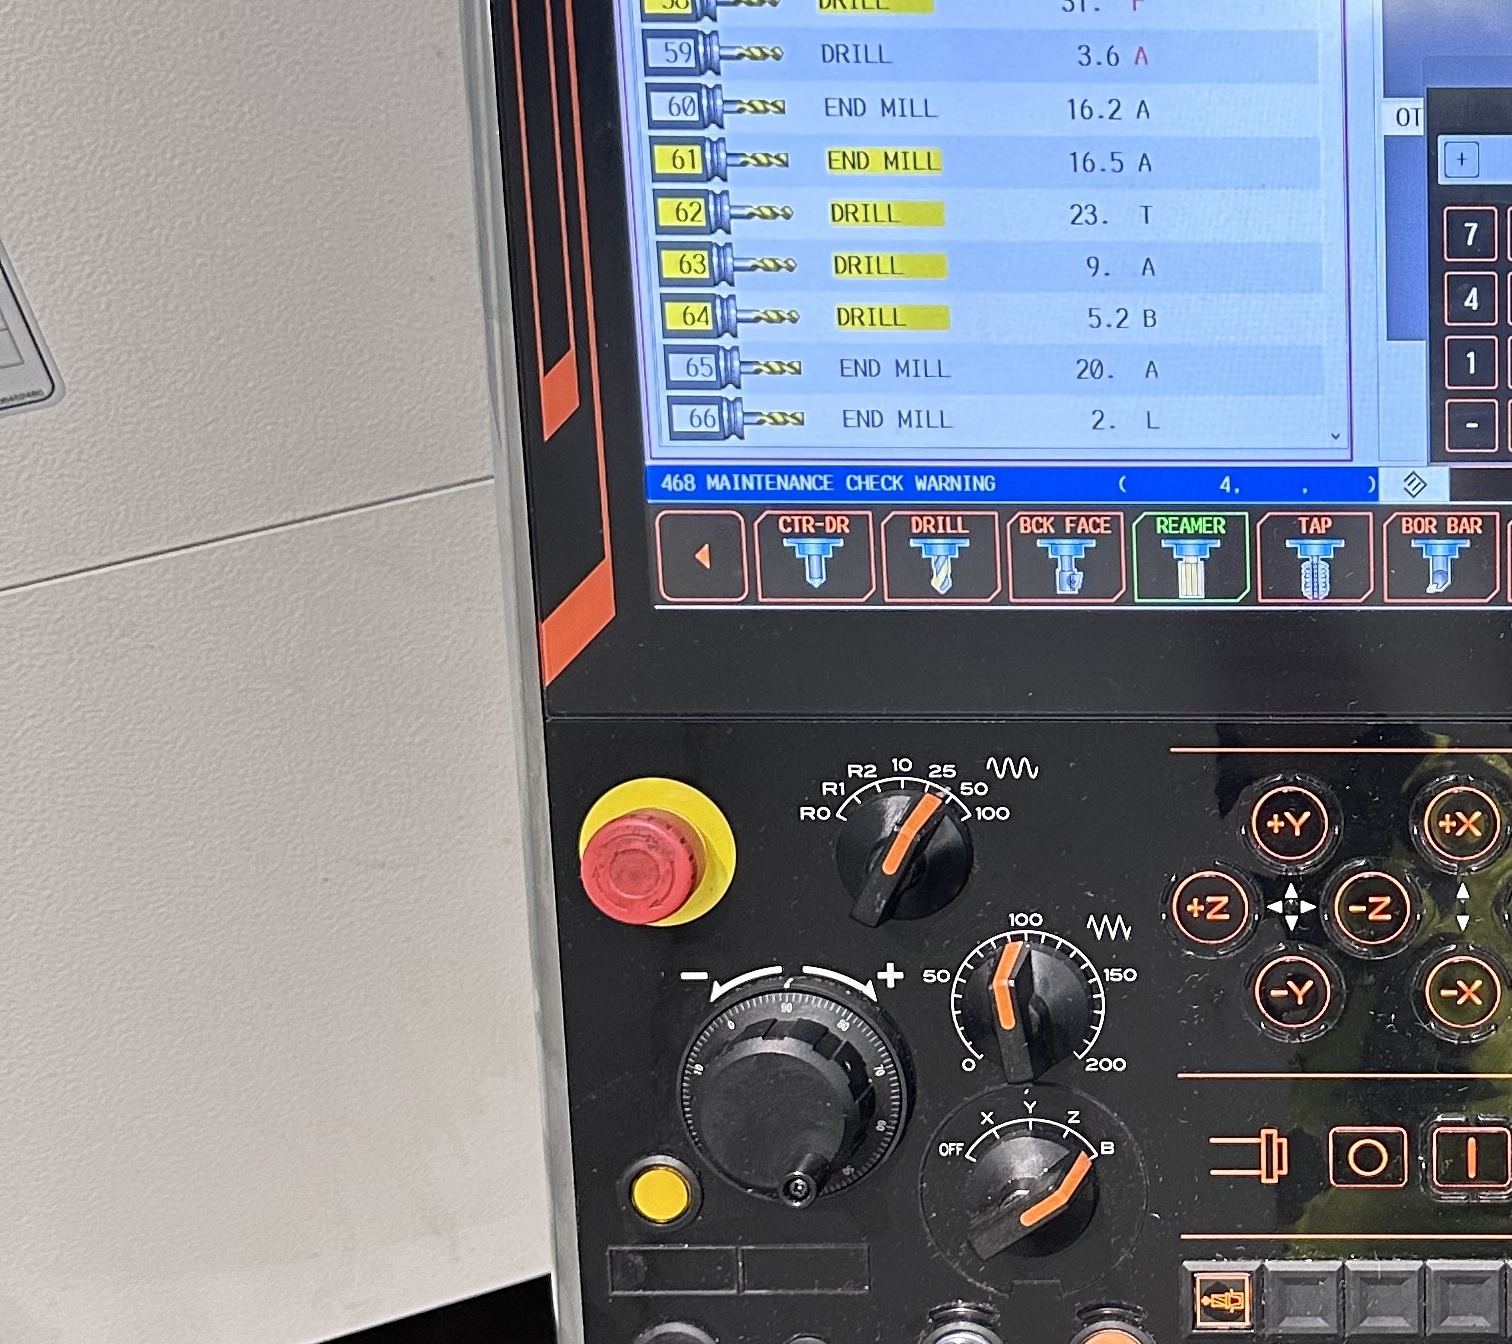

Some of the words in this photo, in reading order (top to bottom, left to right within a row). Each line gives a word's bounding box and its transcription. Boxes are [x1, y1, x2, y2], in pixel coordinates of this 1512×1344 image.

[821, 44, 893, 63] DRILL
[1077, 44, 1120, 66] 3.6
[825, 98, 866, 117] END
[881, 98, 939, 117] MILL
[1068, 98, 1123, 120] 16.2
[672, 149, 698, 170] 61
[828, 151, 869, 171] END
[884, 151, 942, 171] MILL
[1070, 151, 1124, 173] 16.5
[675, 201, 703, 223] 62
[831, 204, 901, 223] DRILL
[834, 256, 905, 275] DRILL
[682, 305, 710, 326] 64
[837, 308, 907, 327] DRILL
[1089, 308, 1129, 329] 5.2
[840, 359, 881, 378] END
[896, 359, 952, 378] MILL
[843, 410, 884, 428] END
[899, 410, 954, 428] MILL
[661, 474, 696, 492] 468
[707, 474, 834, 491] MAINTENANCE
[846, 474, 903, 491] CHECK
[915, 474, 996, 492] WARNING
[778, 516, 850, 534] CTR-DR
[911, 516, 969, 534] DRILL
[1020, 516, 1054, 534] BCK
[1065, 516, 1112, 534] FACE
[1156, 516, 1226, 534] REAMER
[1299, 516, 1333, 534] TAP
[1402, 516, 1439, 535] BOR
[1446, 516, 1483, 535] BAR
[847, 764, 877, 778] R2
[892, 758, 913, 772] 10
[928, 764, 956, 778] 25
[822, 782, 845, 796] R1
[960, 782, 988, 796] 50
[975, 806, 1010, 820] 100
[1267, 811, 1311, 837] +Y
[1439, 811, 1483, 837] +X
[1187, 895, 1230, 920] +Z
[1009, 912, 1044, 927] 100
[923, 969, 951, 983] 50
[1103, 968, 1138, 982] 150
[1085, 1058, 1127, 1072] 200
[939, 1142, 964, 1157] OFF
